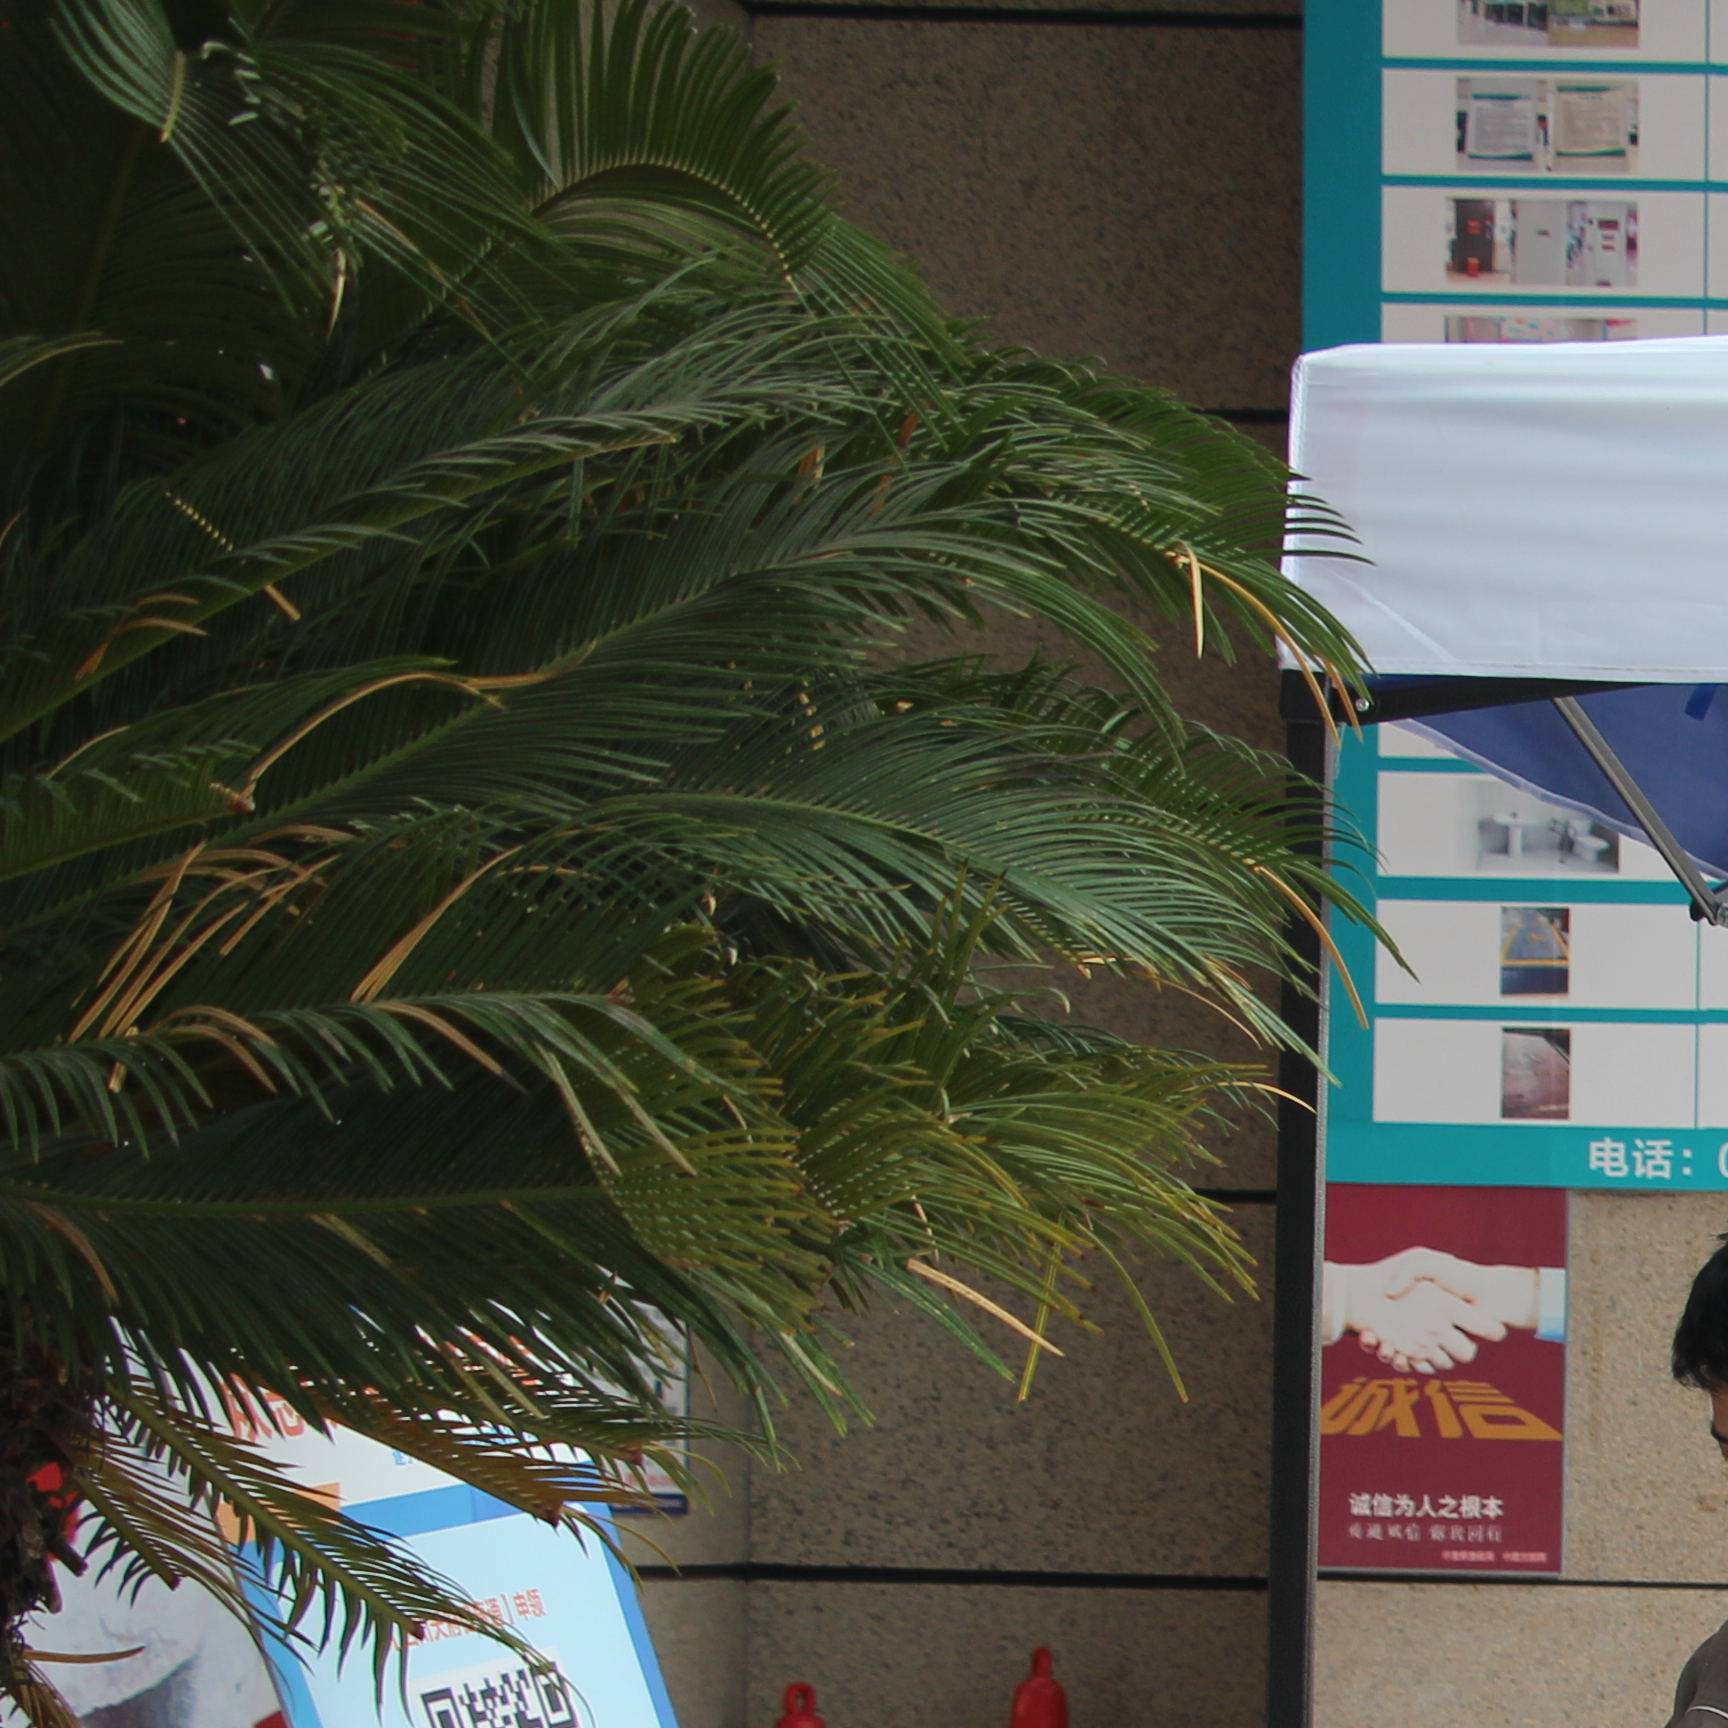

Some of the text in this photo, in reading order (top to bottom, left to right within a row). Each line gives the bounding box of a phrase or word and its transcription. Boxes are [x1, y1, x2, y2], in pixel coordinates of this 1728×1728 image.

[1320, 1376, 1564, 1441] 诚信
[1349, 1491, 1505, 1519] 诚信为人之根本
